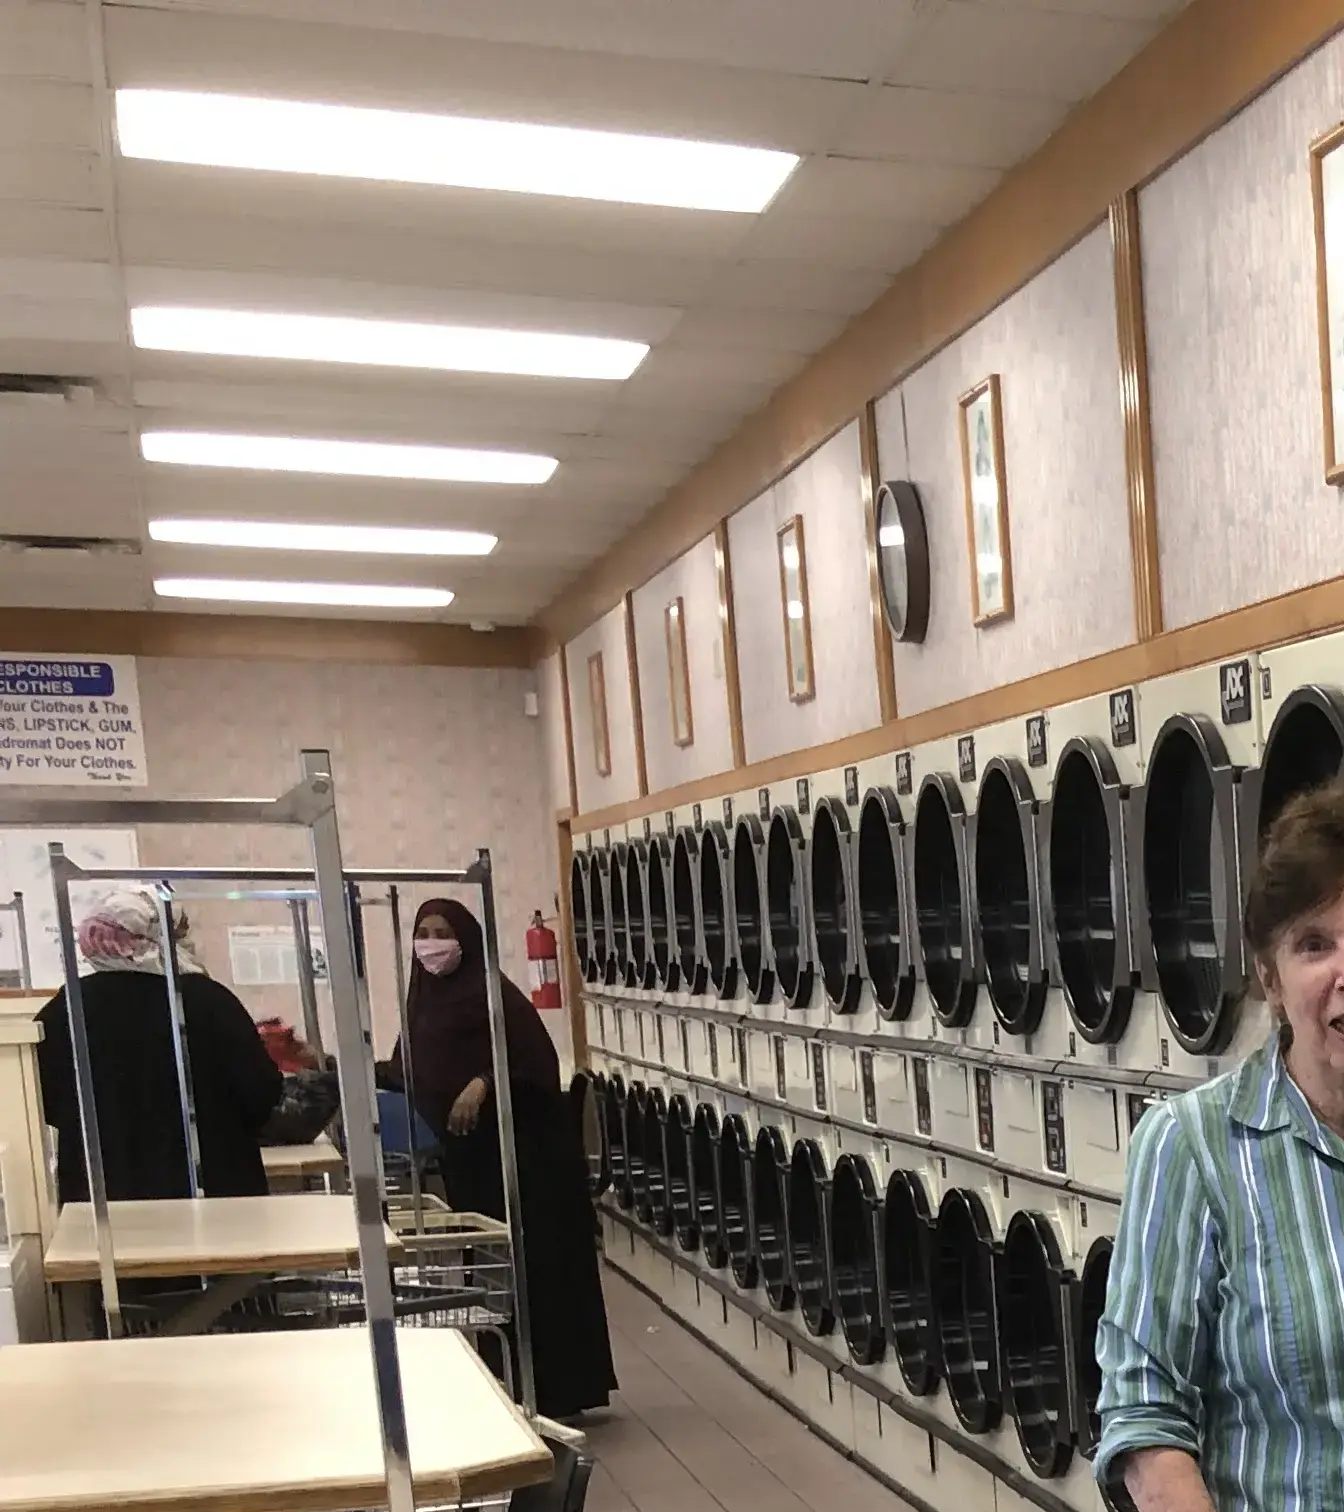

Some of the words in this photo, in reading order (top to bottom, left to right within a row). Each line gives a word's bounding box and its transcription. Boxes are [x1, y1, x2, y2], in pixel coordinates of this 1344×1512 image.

[30, 699, 84, 713] Clothes
[88, 700, 99, 714] &
[102, 700, 129, 714] The
[24, 717, 94, 733] LIPSTICK,
[56, 736, 91, 750] Does
[95, 737, 126, 751] NOT
[16, 754, 40, 767] For
[44, 753, 77, 768] Your
[80, 755, 137, 769] Clothes.
